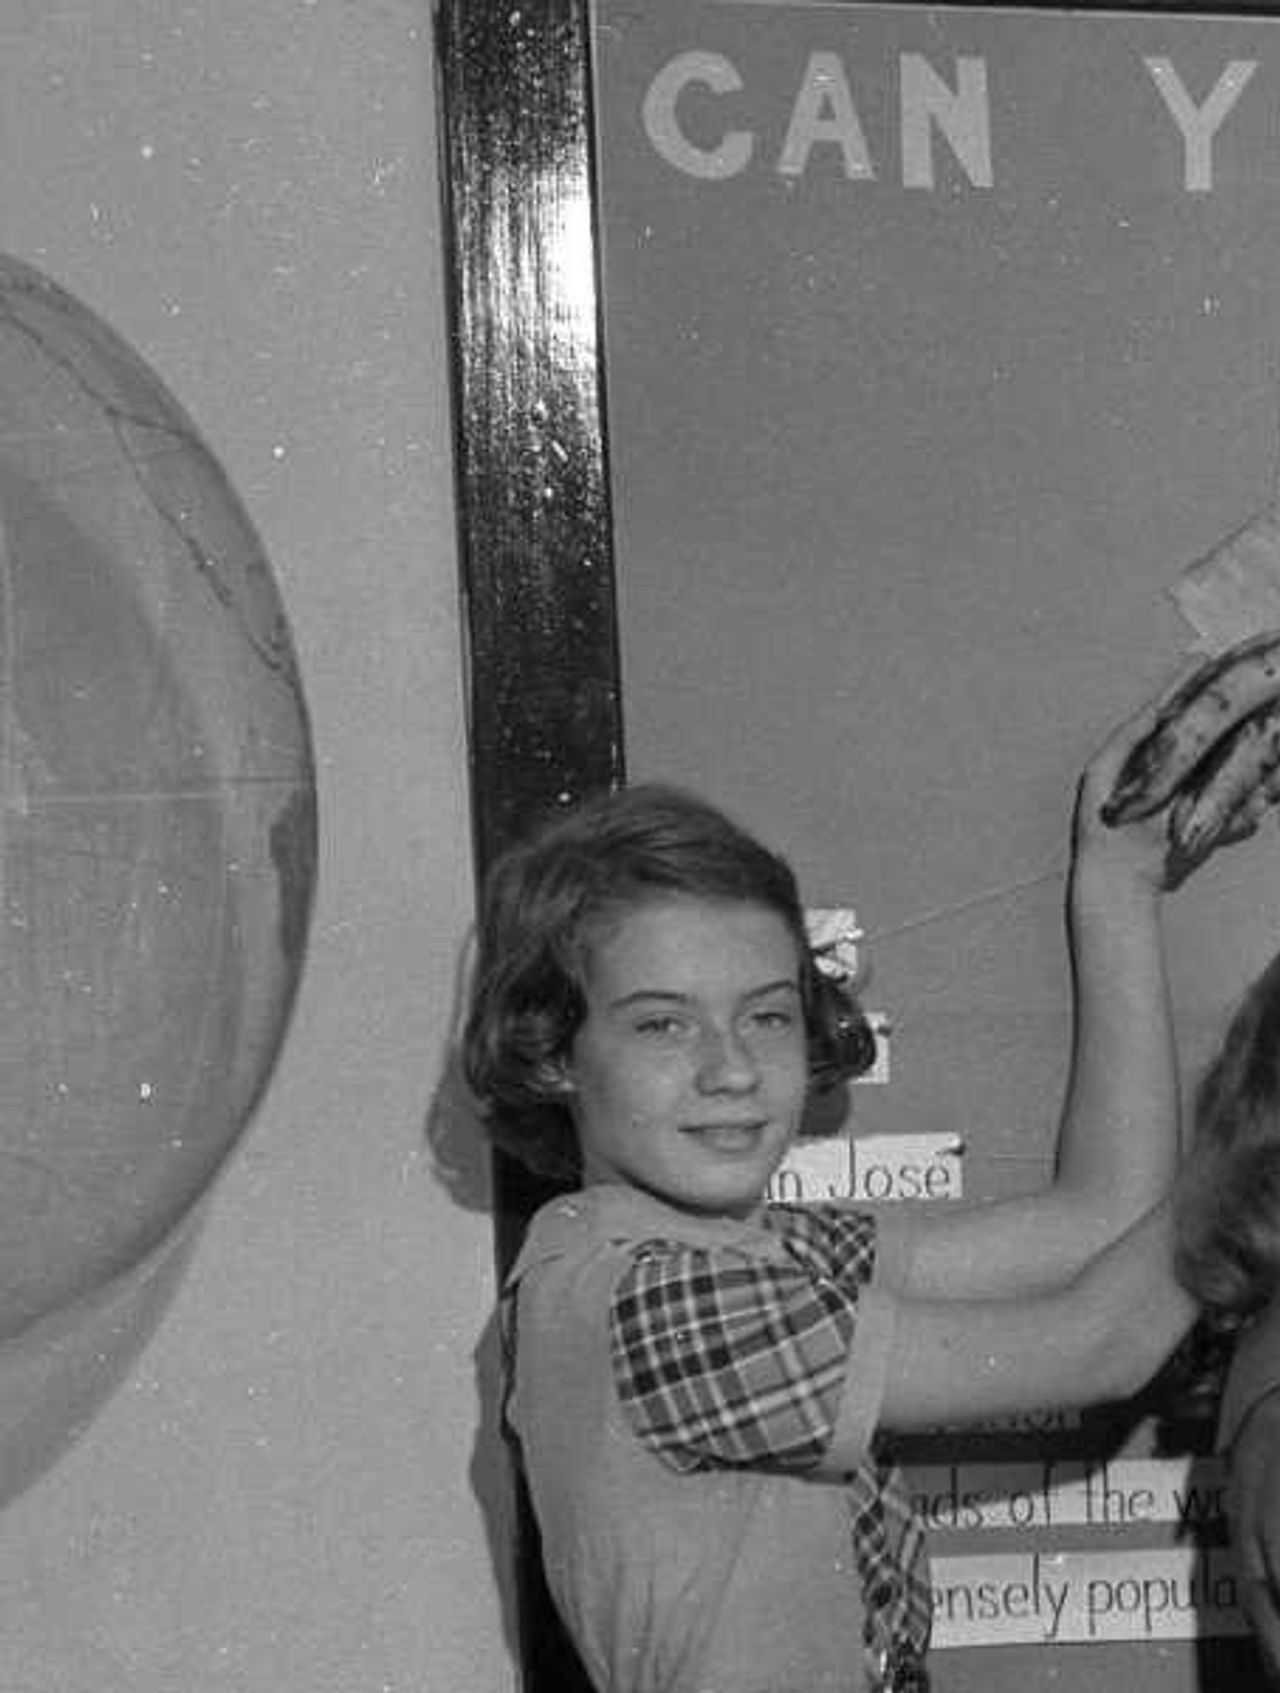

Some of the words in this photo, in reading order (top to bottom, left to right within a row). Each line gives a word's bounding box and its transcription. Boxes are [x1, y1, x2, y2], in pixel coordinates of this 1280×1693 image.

[642, 51, 994, 189] CAN
[1010, 1461, 1057, 1528] of
[1082, 1461, 1153, 1526] the
